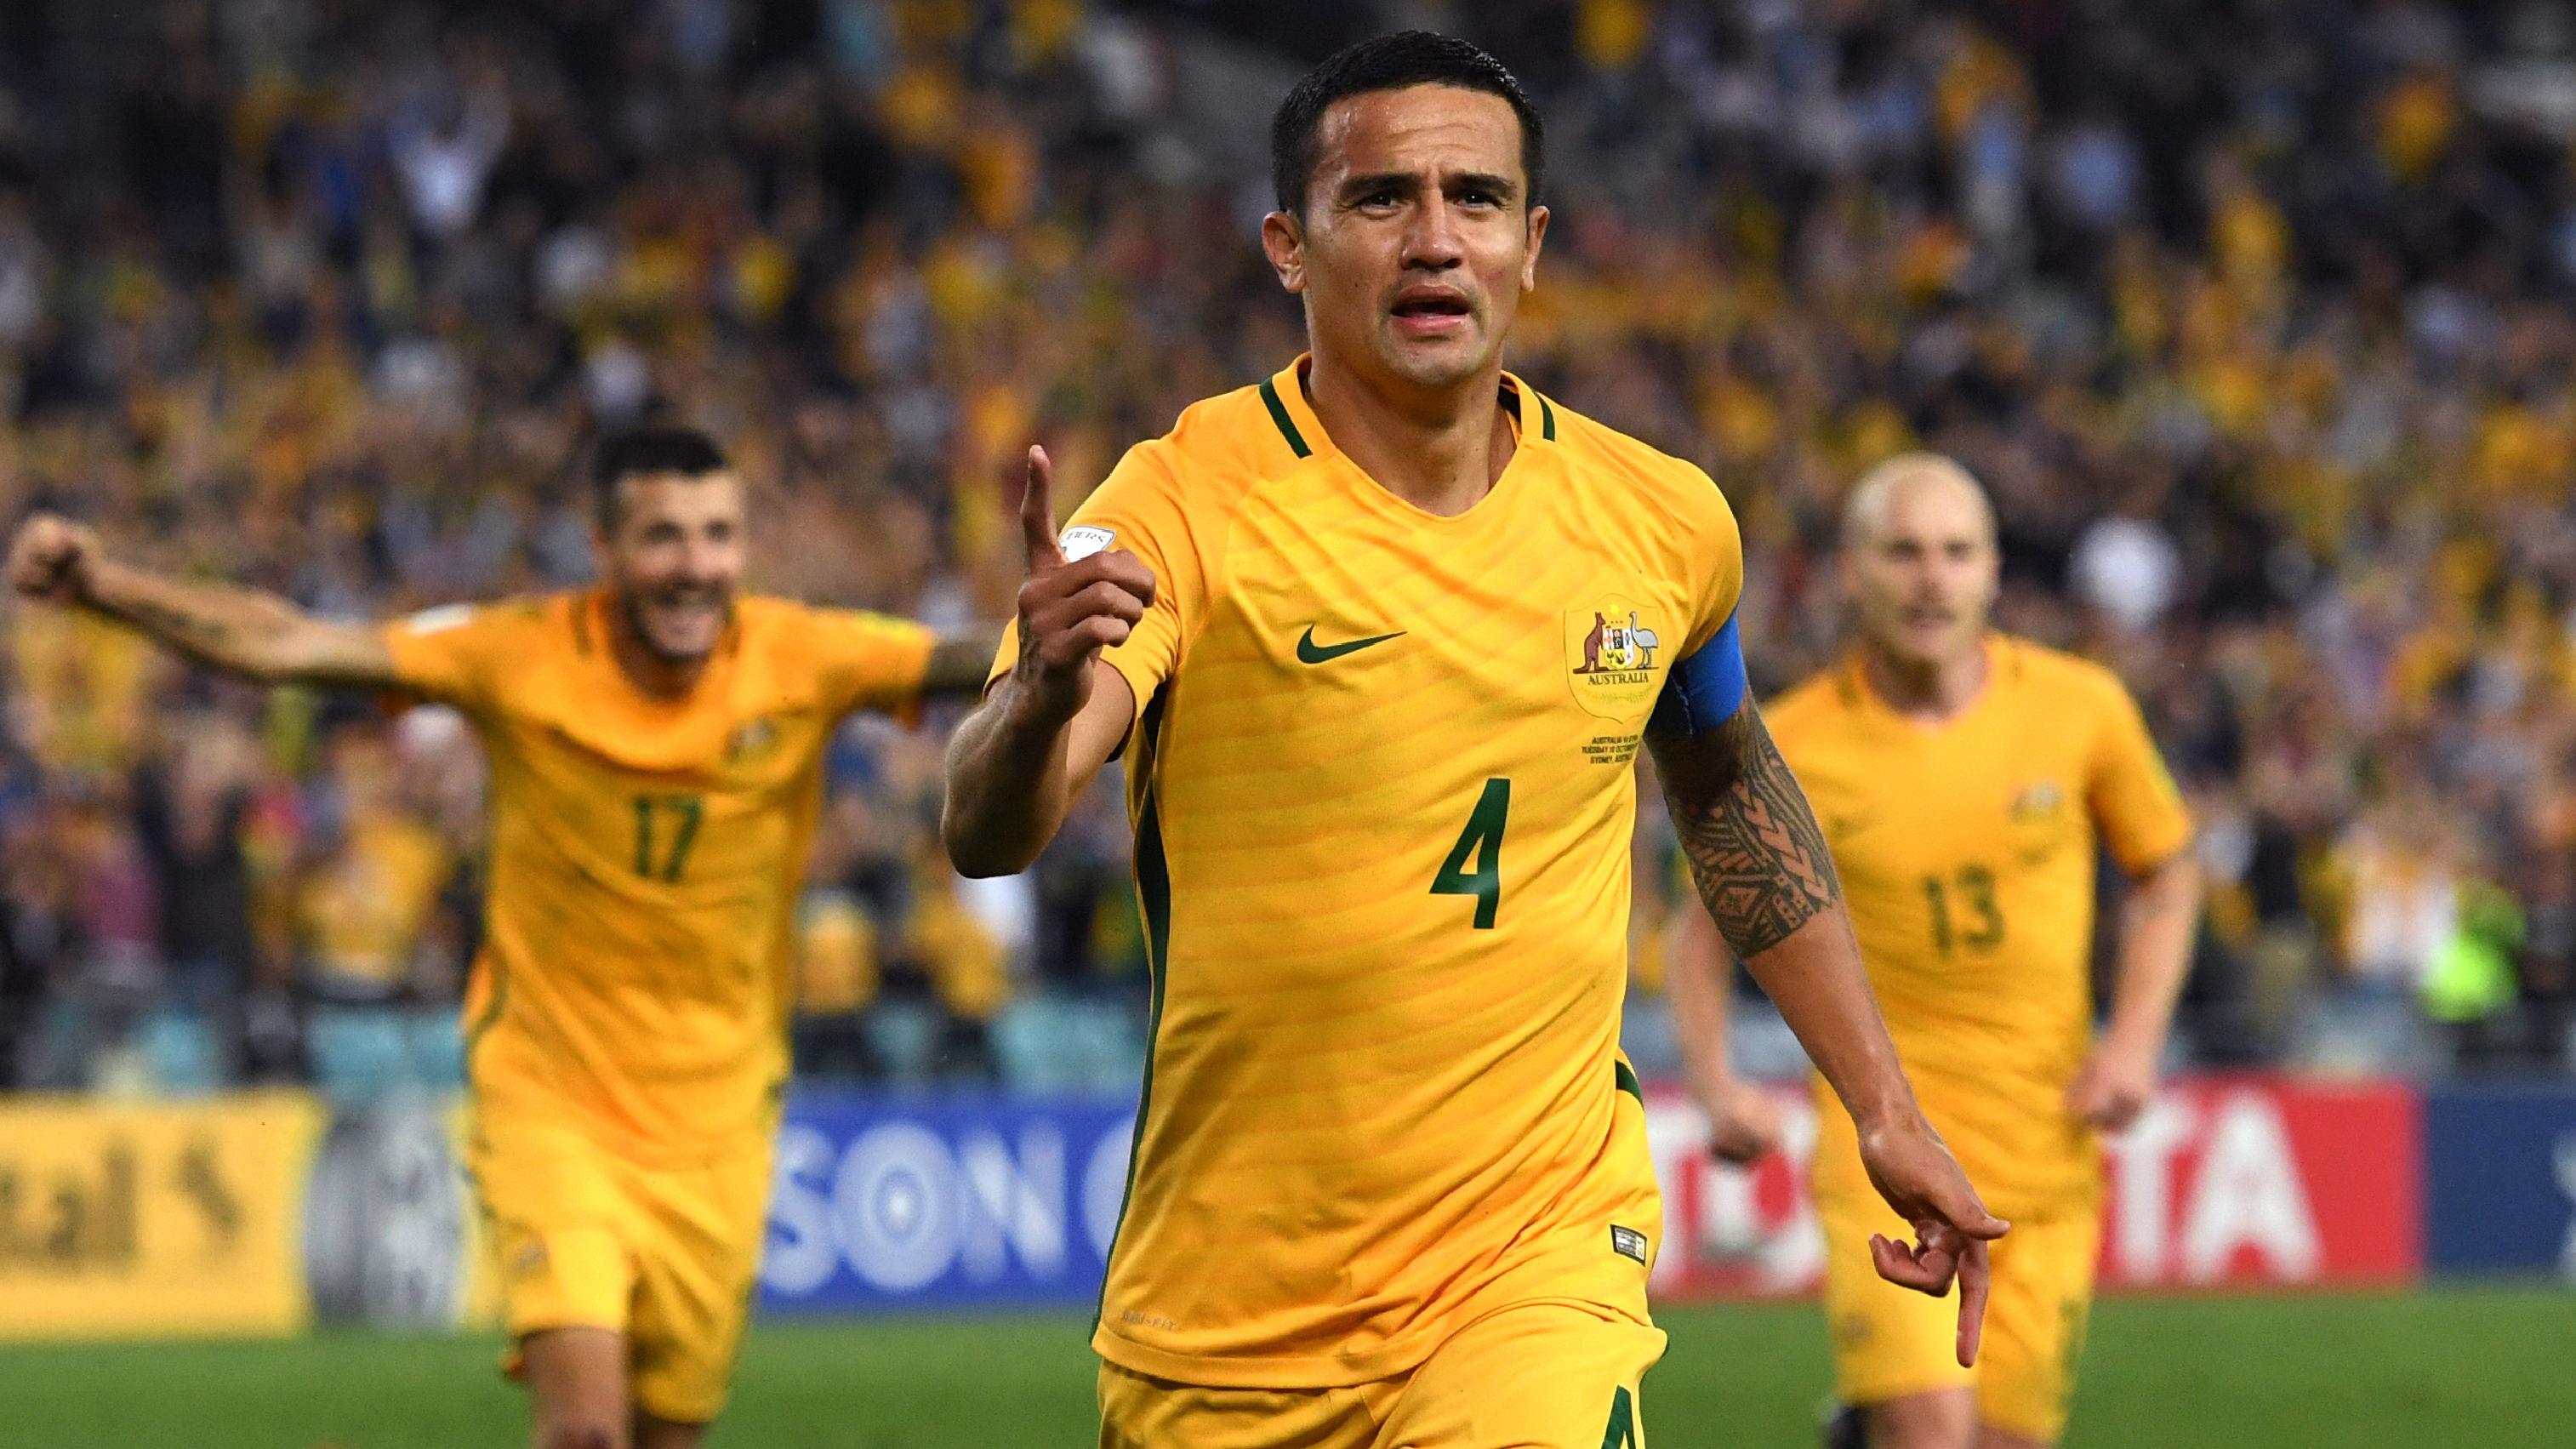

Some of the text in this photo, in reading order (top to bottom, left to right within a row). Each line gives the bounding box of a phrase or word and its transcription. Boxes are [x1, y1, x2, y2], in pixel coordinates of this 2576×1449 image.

[1588, 671, 1650, 686] AUSTRALIA
[632, 792, 703, 883] 17
[1429, 778, 1511, 929] 4
[1921, 861, 2005, 960] 13
